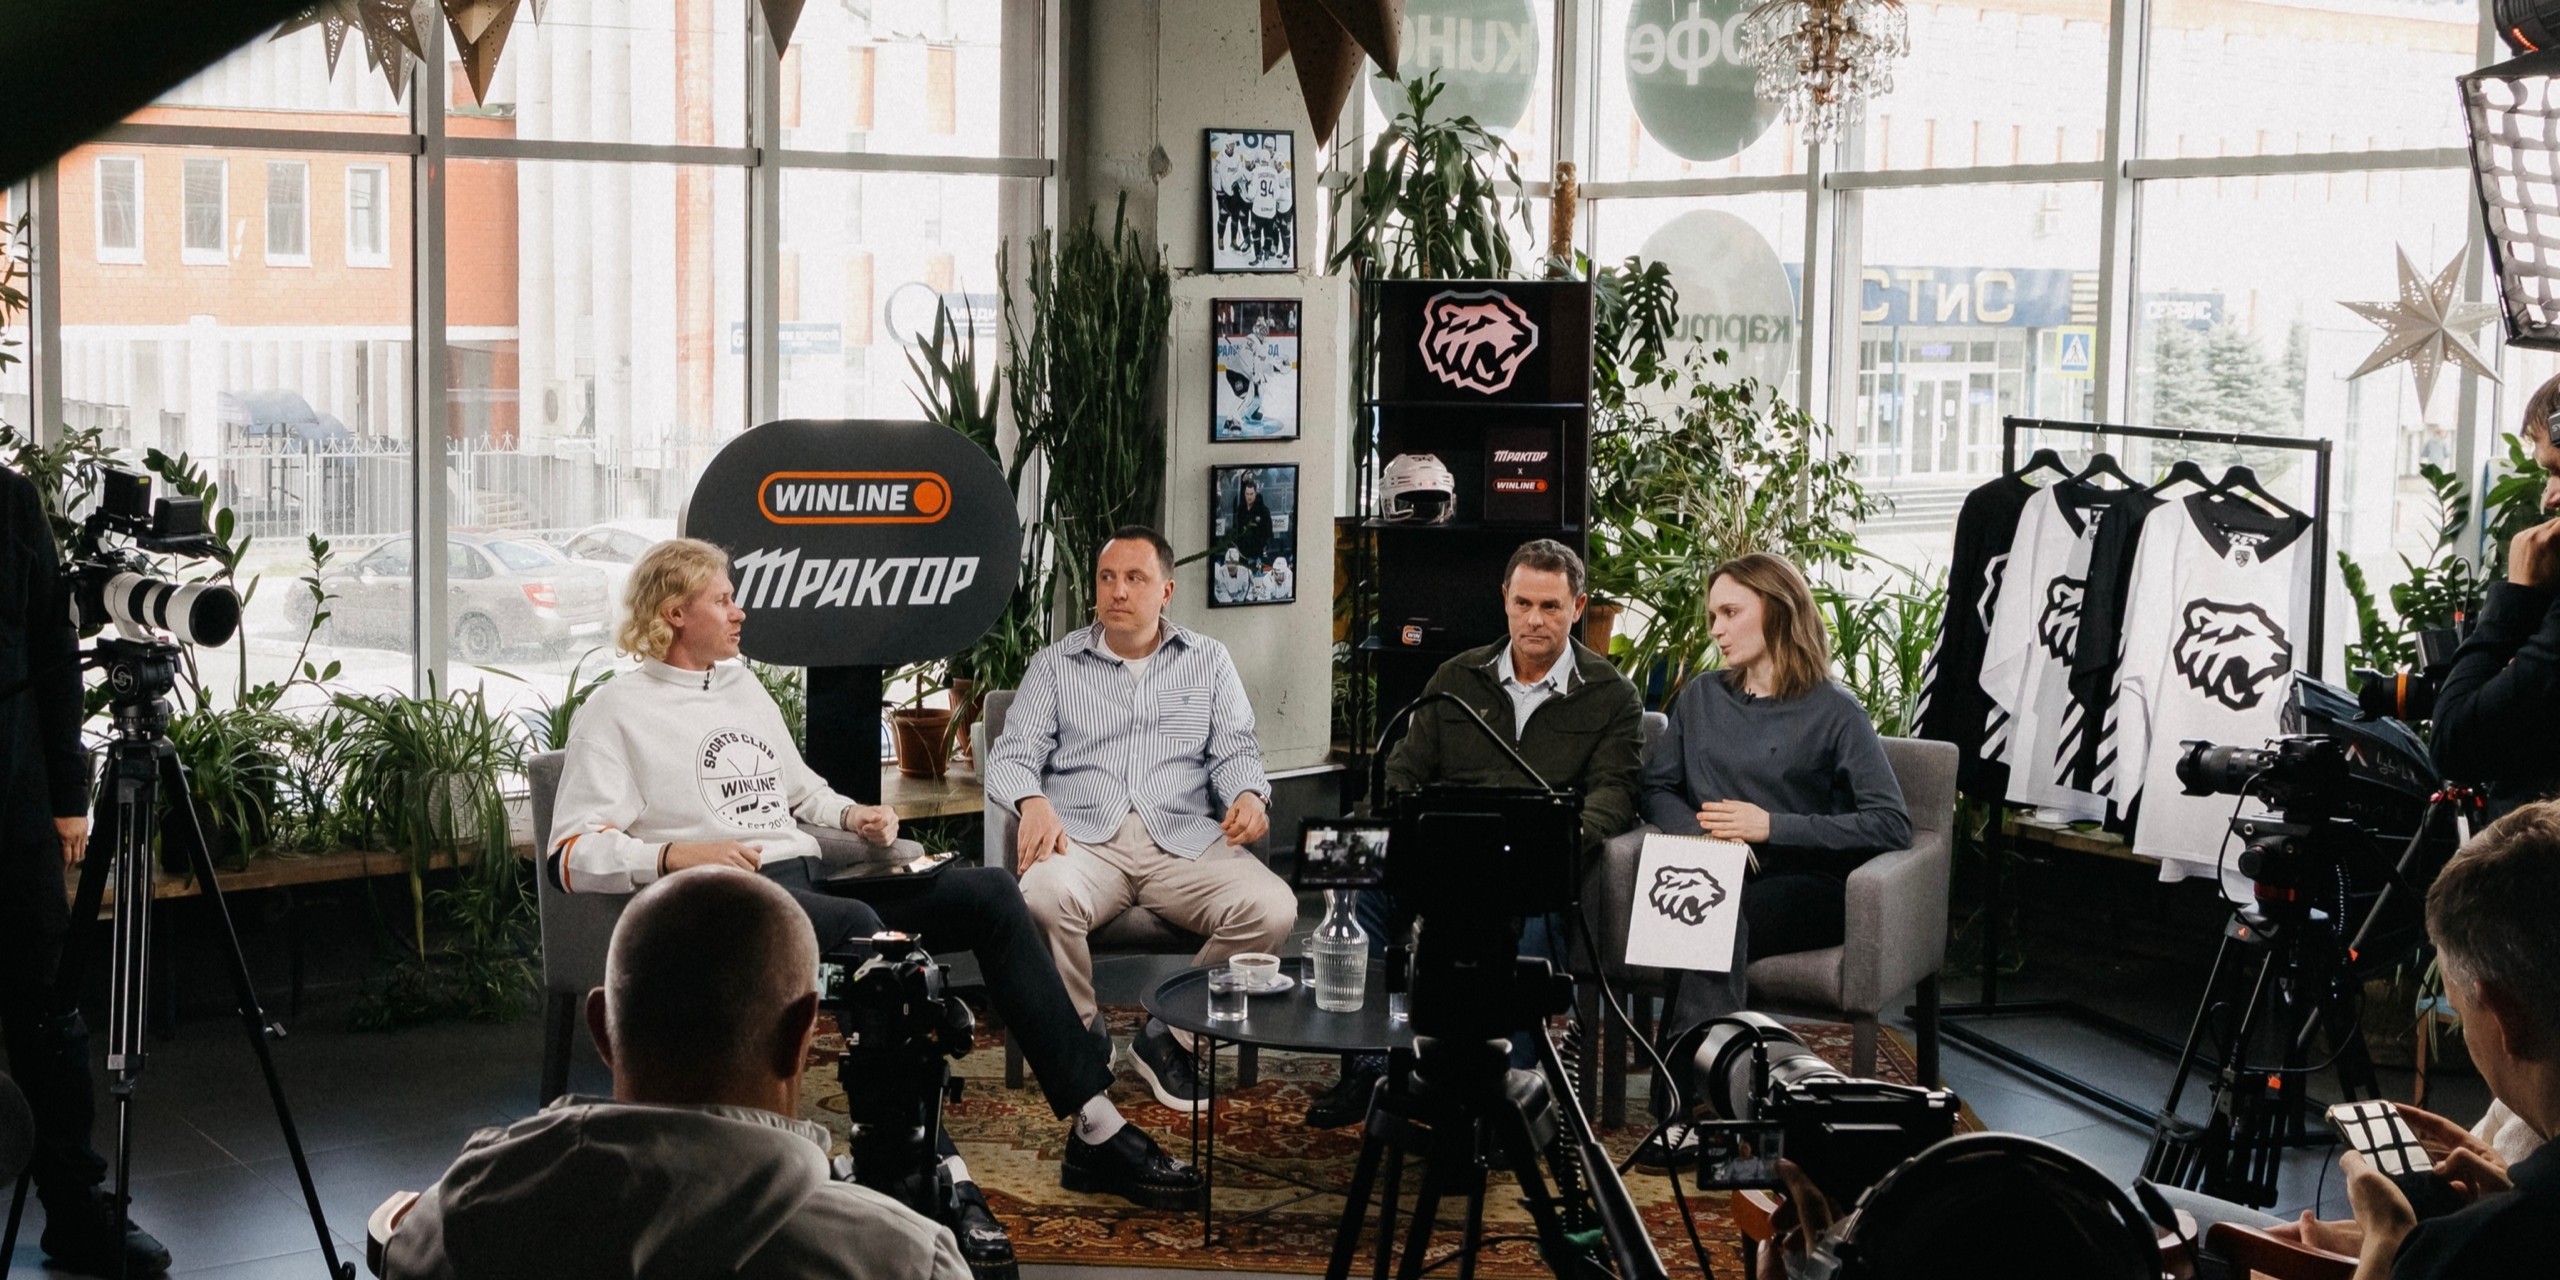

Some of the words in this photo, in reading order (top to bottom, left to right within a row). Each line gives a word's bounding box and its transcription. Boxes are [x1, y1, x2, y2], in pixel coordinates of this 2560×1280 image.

[1260, 179, 1275, 199] 94
[1861, 267, 2016, 323] СТиС
[775, 484, 909, 512] WINLINE
[1496, 481, 1536, 490] WINLINE
[703, 732, 740, 769] SPORTS
[740, 734, 775, 760] CLUB
[720, 776, 776, 799] WINLINE
